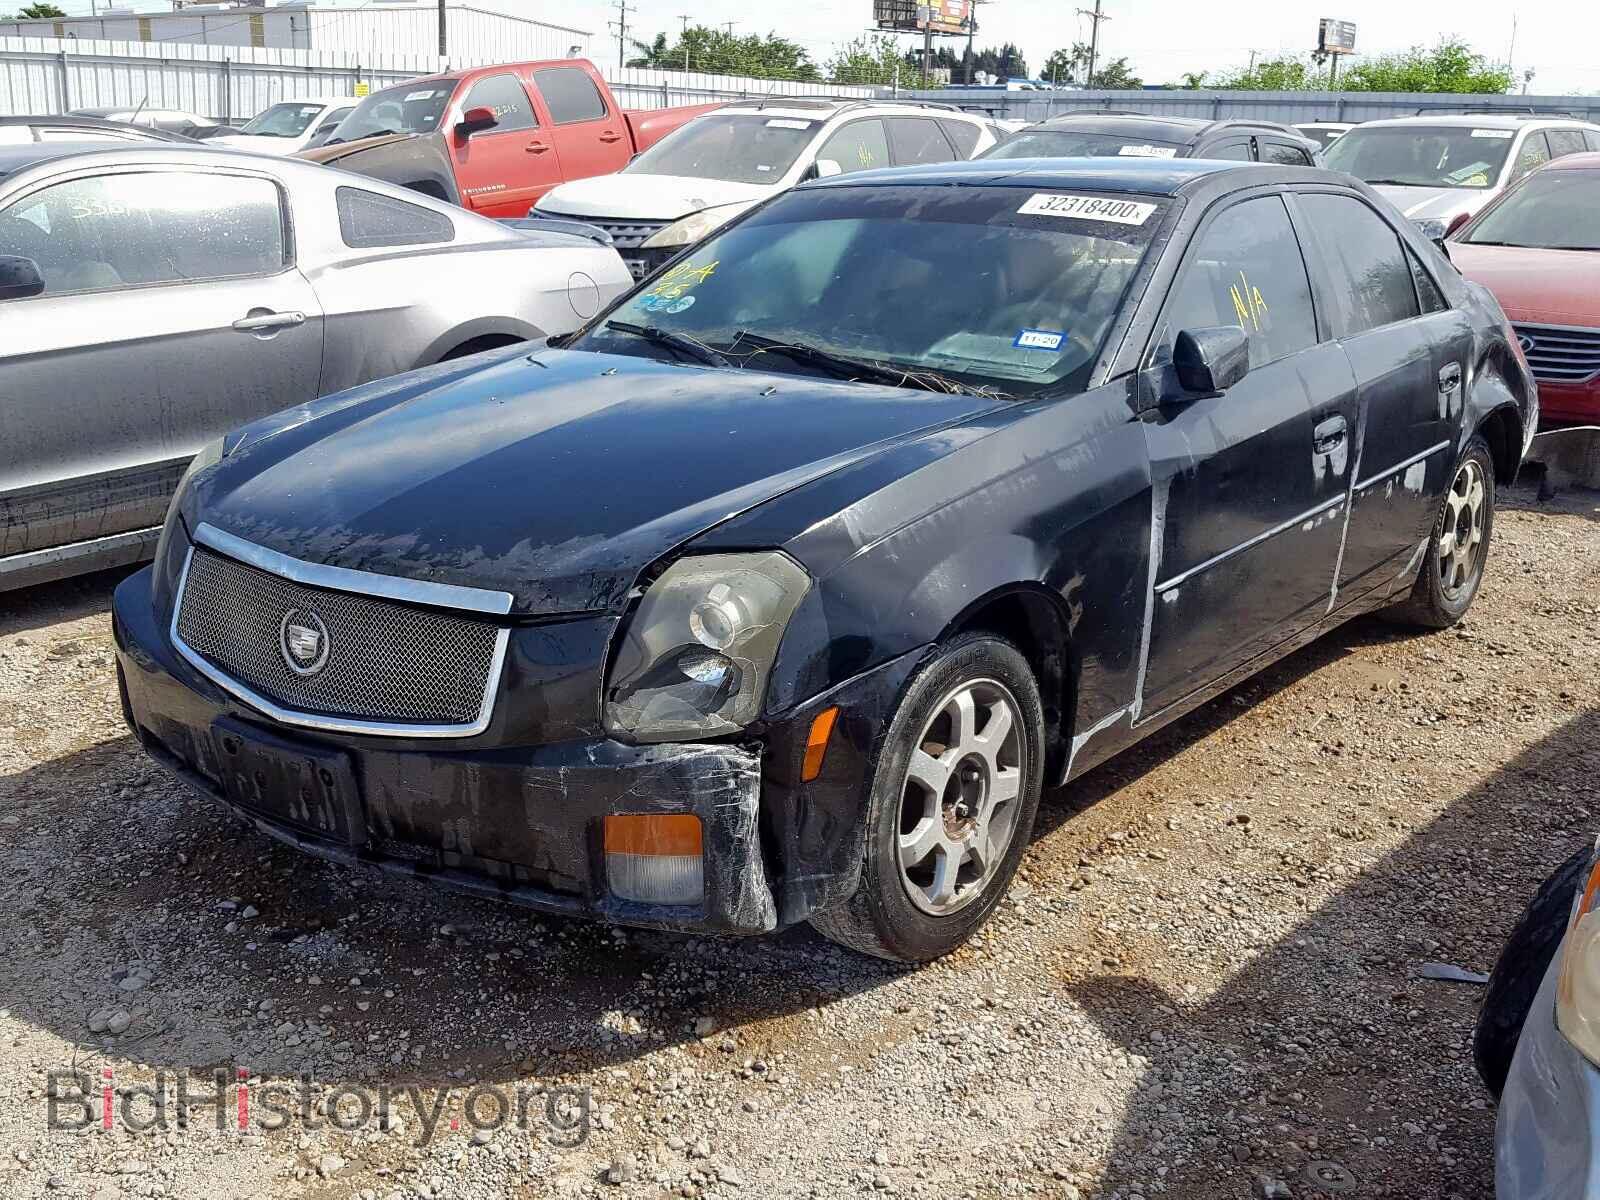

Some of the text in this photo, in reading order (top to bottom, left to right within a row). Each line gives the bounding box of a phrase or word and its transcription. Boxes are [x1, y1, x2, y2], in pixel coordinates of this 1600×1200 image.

[1039, 196, 1137, 219] 32318400
[1230, 270, 1268, 331] N/A
[1024, 335, 1058, 345] 11-20
